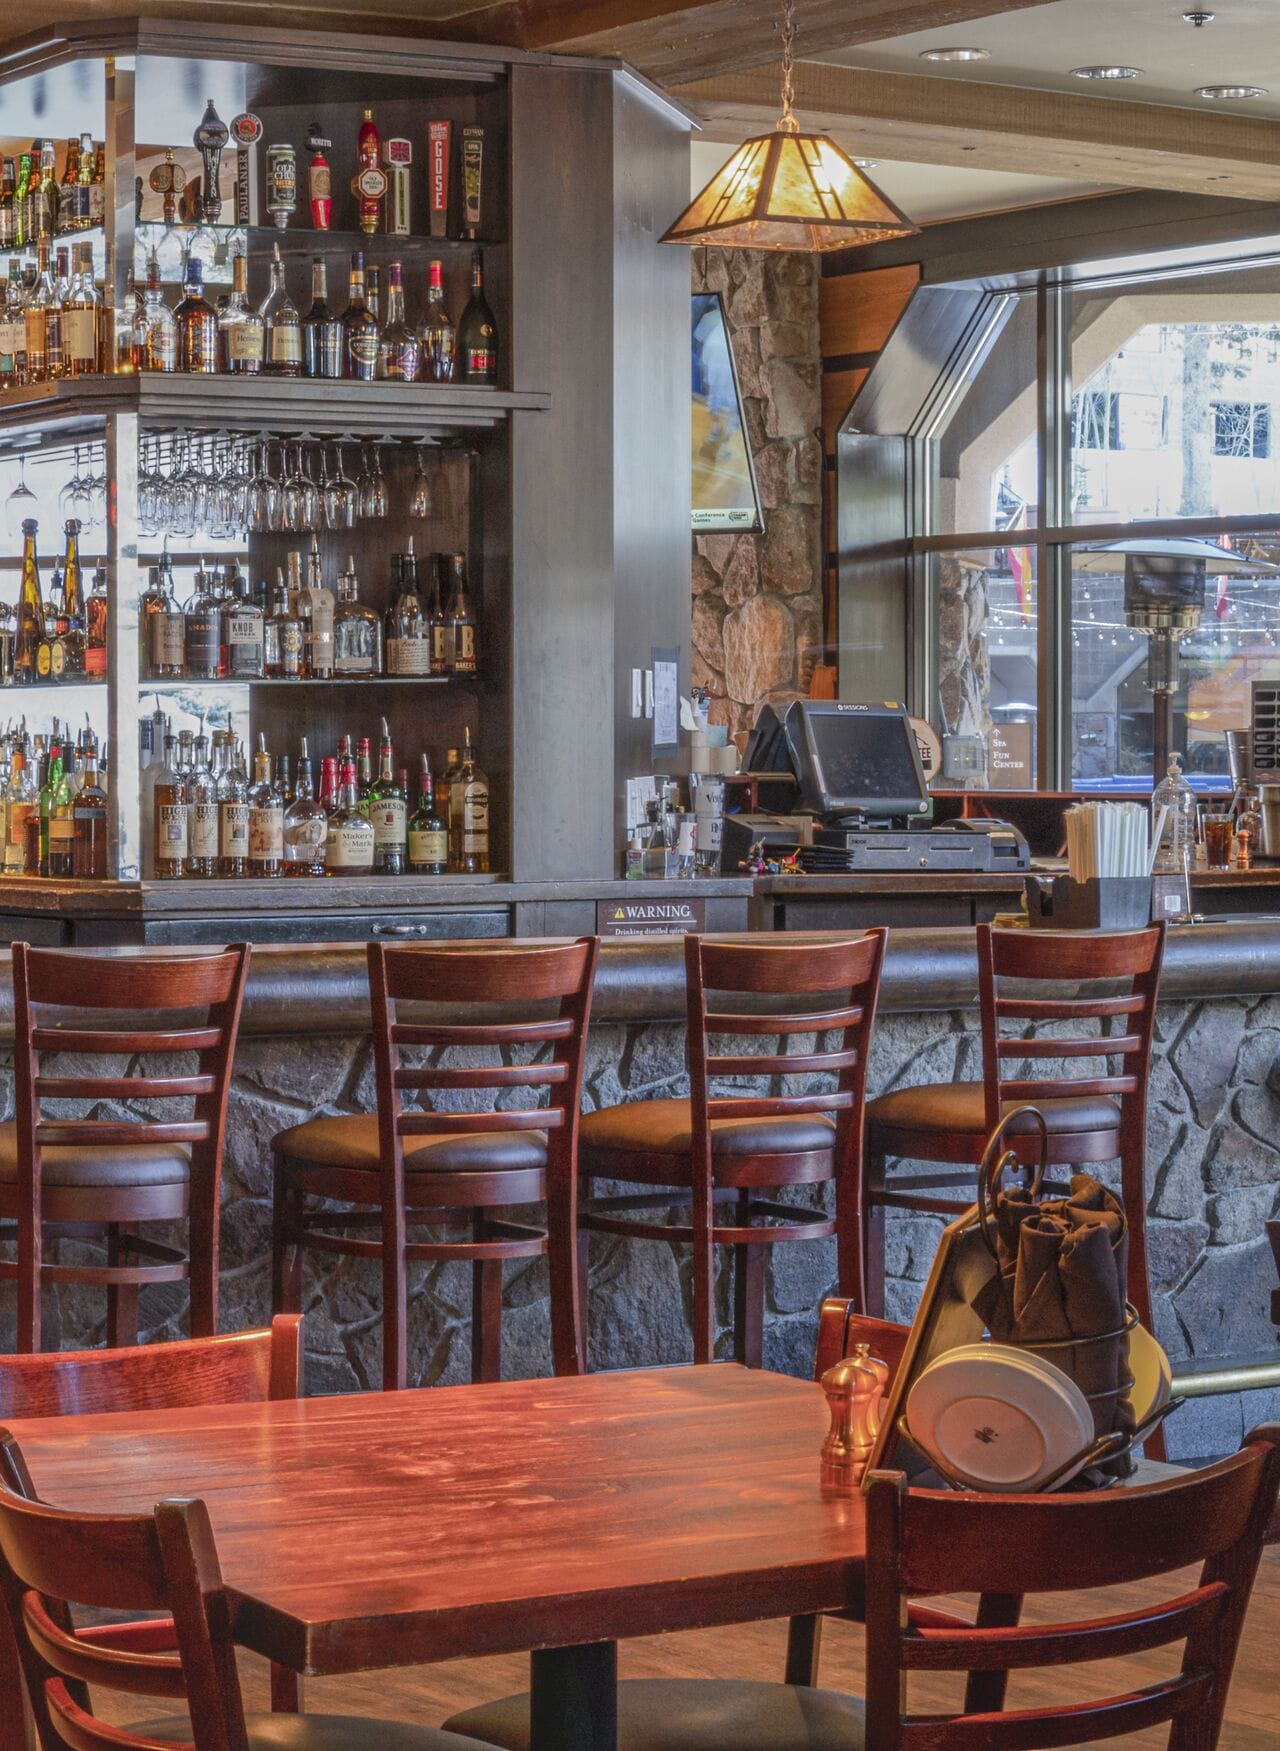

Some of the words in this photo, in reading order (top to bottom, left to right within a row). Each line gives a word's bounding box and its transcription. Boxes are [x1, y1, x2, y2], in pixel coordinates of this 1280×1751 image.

[277, 164, 294, 172] OLD
[435, 141, 443, 209] GOSE
[240, 153, 249, 220] PAULANER
[232, 623, 253, 632] KNOB
[372, 802, 405, 812] JAMESON
[342, 832, 372, 840] Maker's
[351, 840, 372, 848] Mark
[626, 904, 691, 918] WARNING
[615, 928, 643, 936] Drinking
